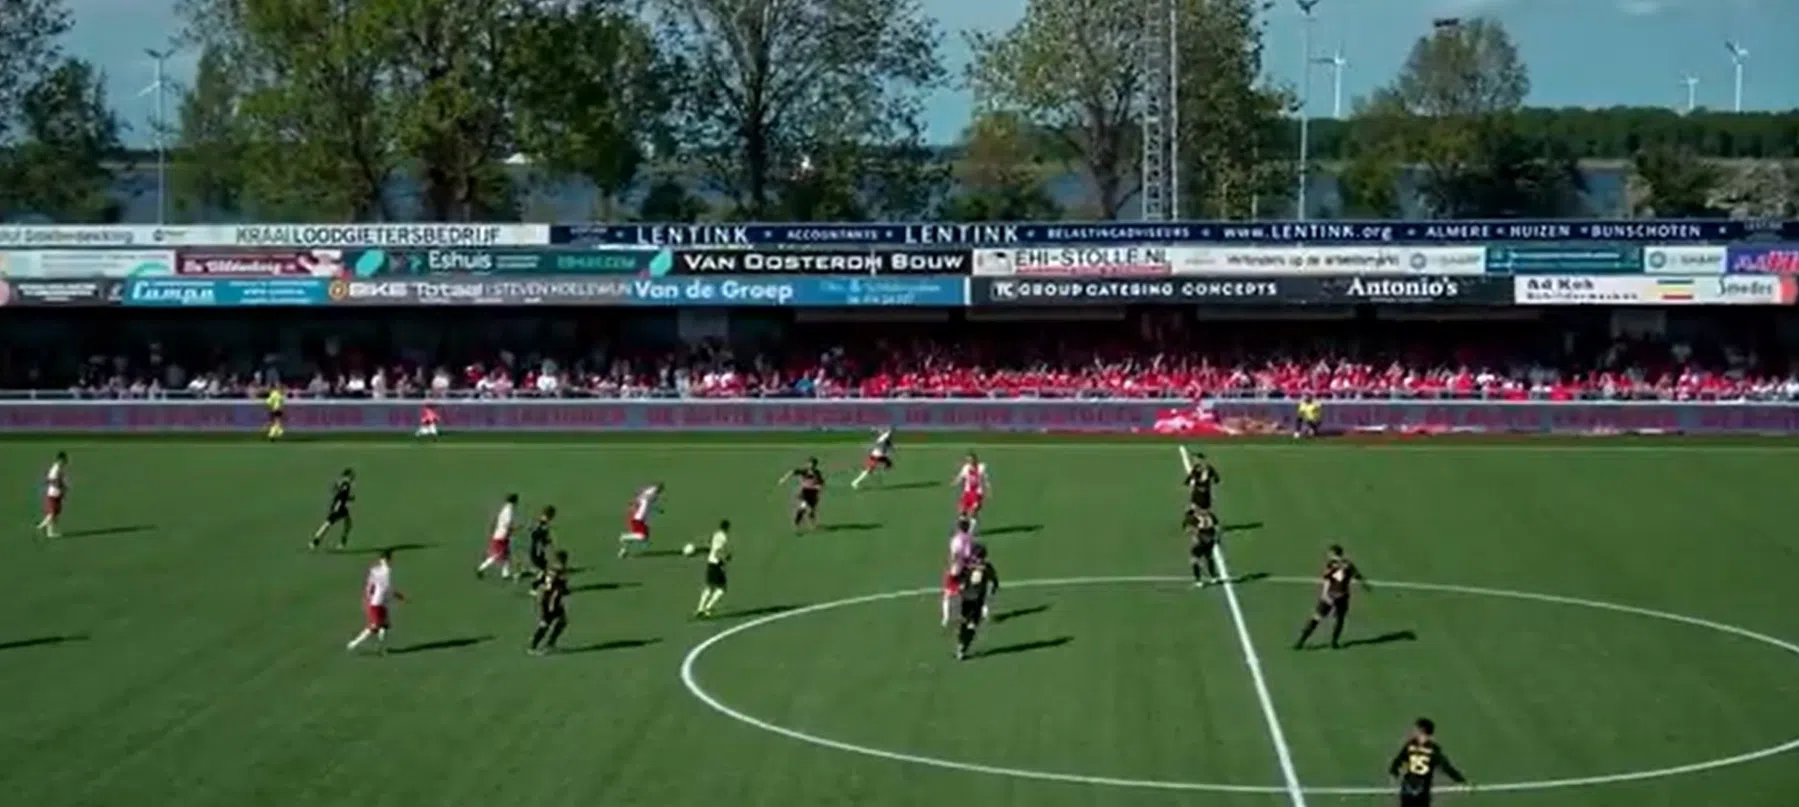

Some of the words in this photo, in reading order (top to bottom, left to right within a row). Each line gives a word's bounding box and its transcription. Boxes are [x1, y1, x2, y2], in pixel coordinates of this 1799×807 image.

[637, 226, 748, 244] LENTINK
[787, 229, 877, 240] ACCOUNTANTS
[905, 225, 1018, 243] LENTINK
[1425, 225, 1489, 237] ALMERE
[1510, 225, 1571, 237] HUIZEN
[1591, 224, 1700, 237] BUNSCHOTEN
[635, 280, 679, 298] Van
[686, 280, 714, 298] de
[722, 280, 793, 304] Groep
[1346, 276, 1458, 297] Antonio's
